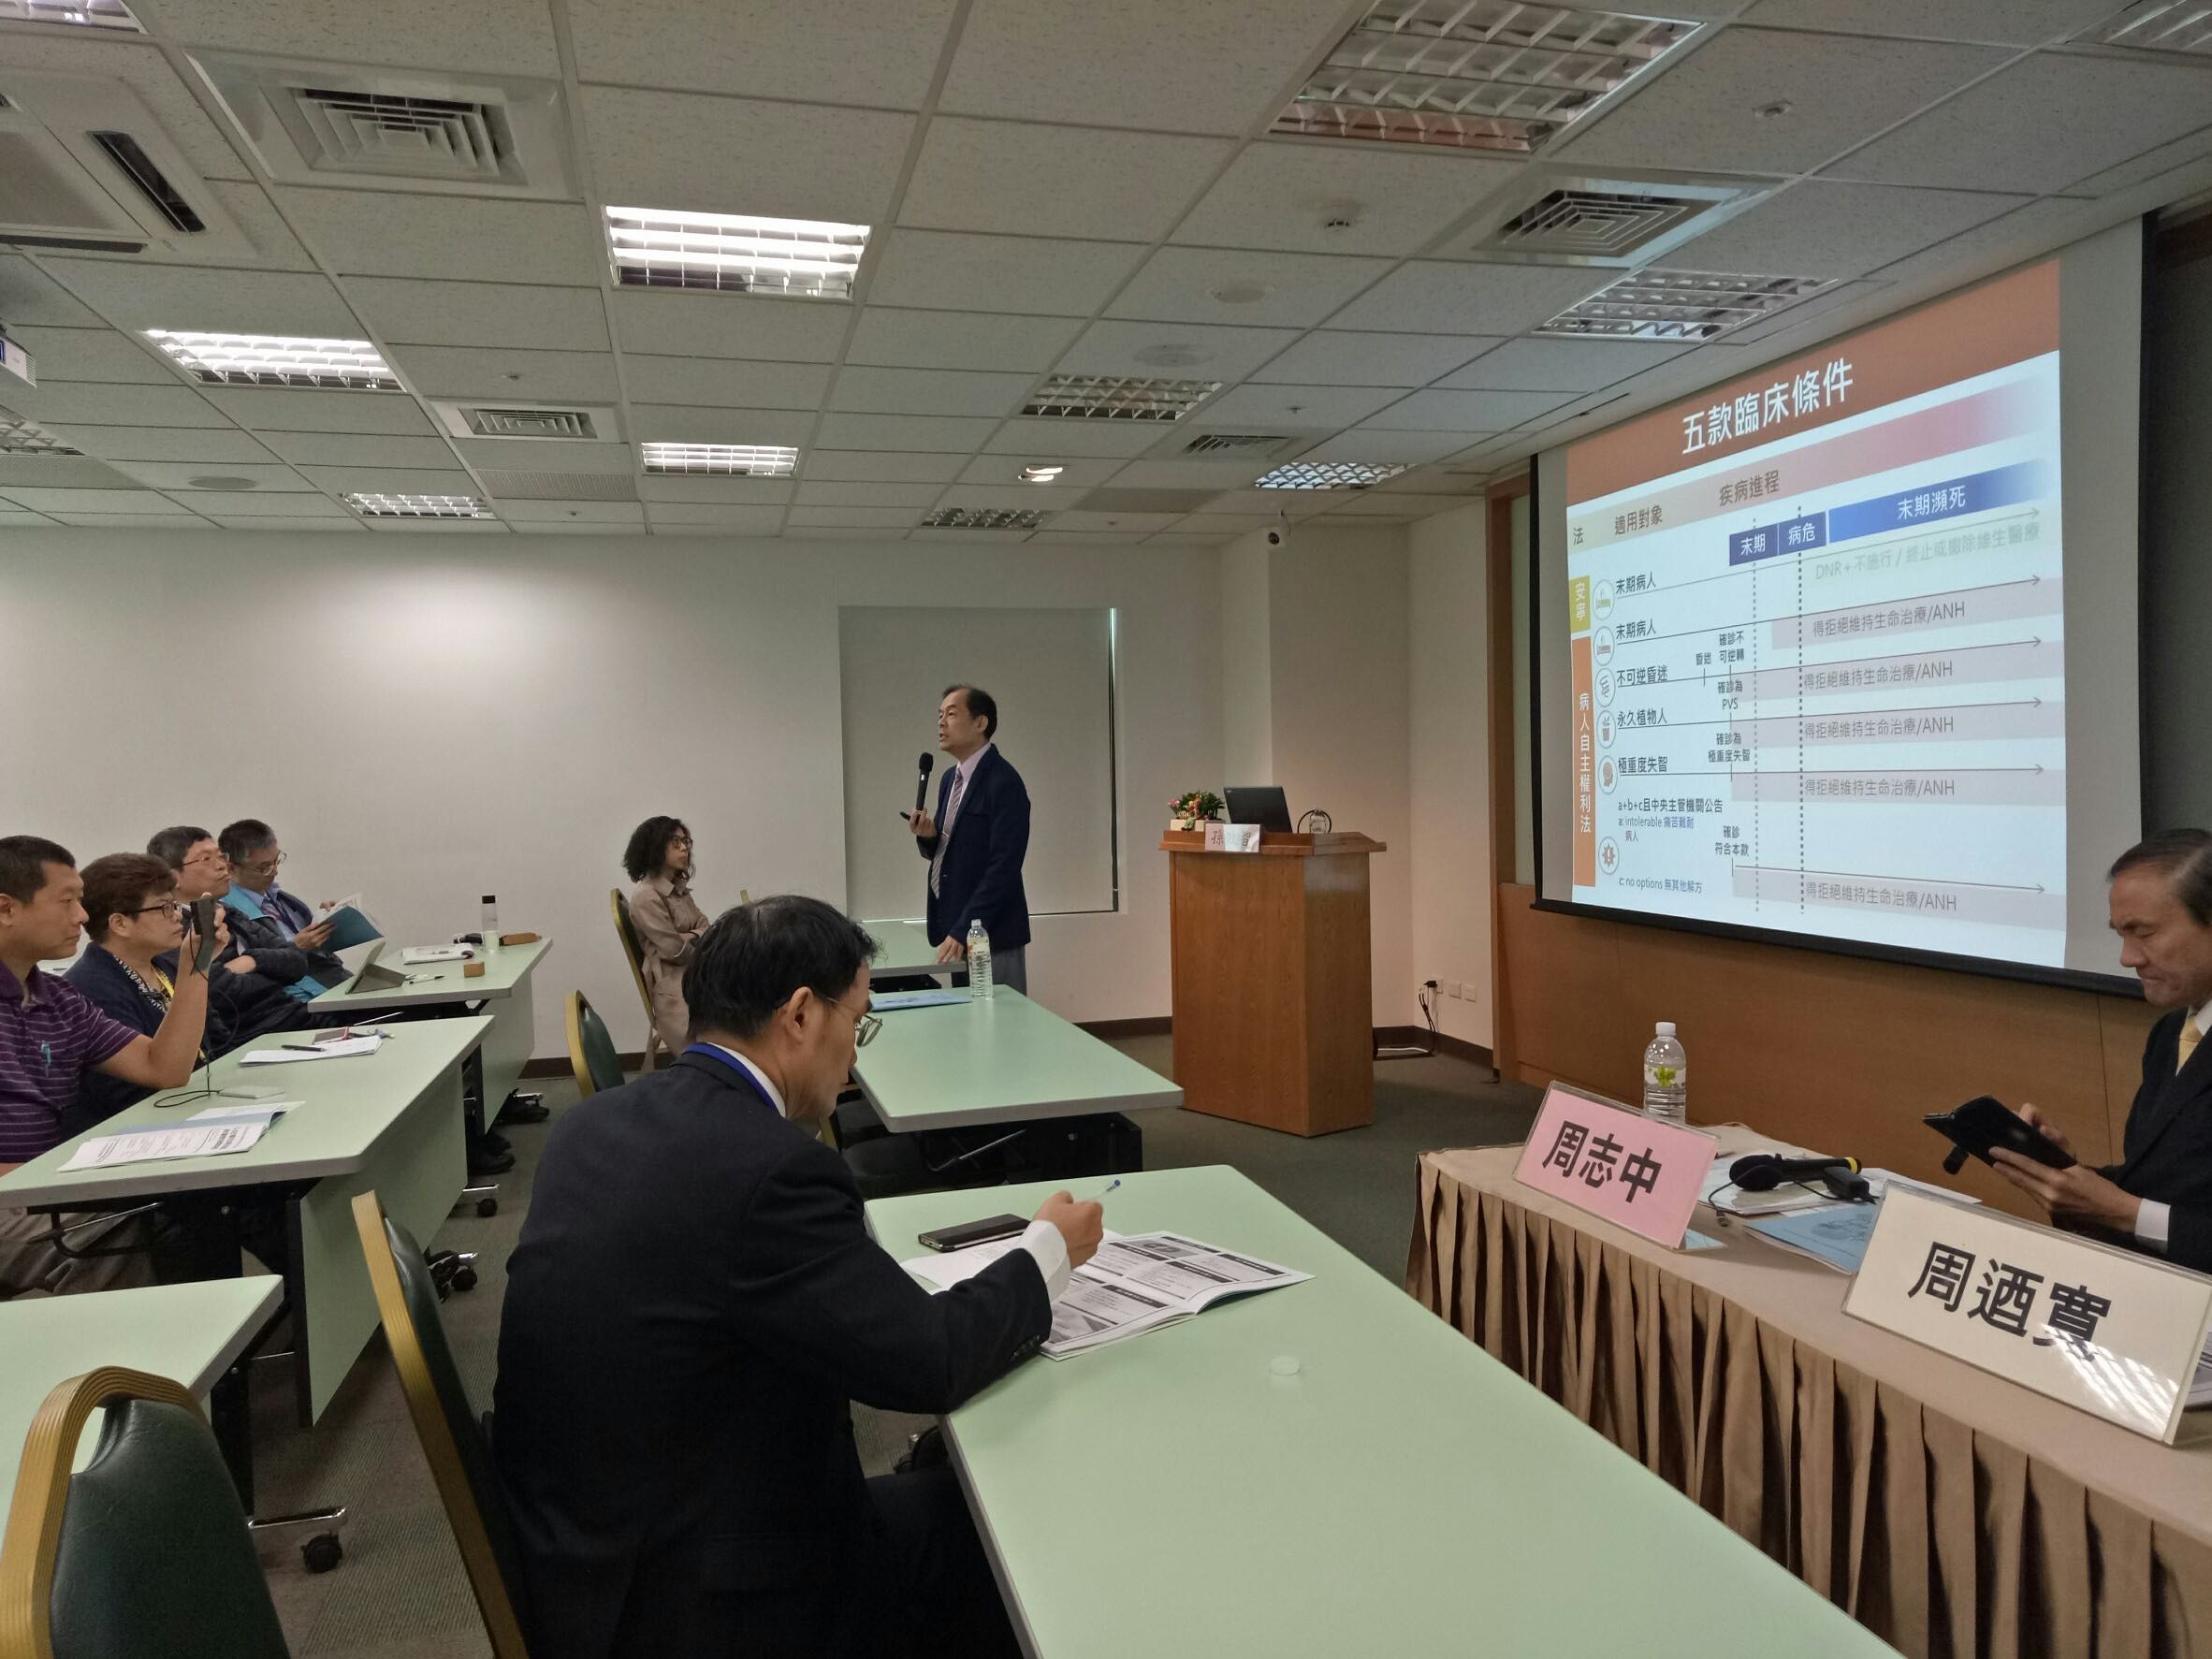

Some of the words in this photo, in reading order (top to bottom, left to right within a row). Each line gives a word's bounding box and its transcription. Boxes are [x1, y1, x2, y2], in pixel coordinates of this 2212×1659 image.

[1682, 357, 1854, 454] 五款臨床條件
[1719, 470, 1780, 506] 疾病進程
[1898, 485, 1966, 520] 末期瀕死
[1614, 505, 1663, 536] 適用對象
[1573, 527, 1585, 546] 法
[1740, 533, 1766, 556] 末期
[1788, 522, 1815, 546] 病危
[1815, 561, 1841, 579] DNR
[1616, 572, 1656, 594] 末期病人
[1576, 582, 1586, 621] 安寧
[1616, 618, 1656, 640] 末期病人
[1812, 602, 1966, 638] 得拒絕維持生命治療/ANH
[1617, 665, 1667, 686] 不可逆昏迷
[1804, 661, 1953, 690] 得拒絕維持生命治療/ANH
[1722, 698, 1739, 710] PVS
[1617, 707, 1667, 726] 永久植物人
[1804, 717, 1954, 739] 得拒絕維持生命治療/ANH
[1579, 692, 1591, 833] 病人自主權利法
[1618, 756, 1667, 774] 極重度失智
[1804, 779, 1955, 797] 得拒絕維持生命治療/ANH
[1625, 816, 1663, 827] intolerable
[1636, 879, 1663, 890] options
[1542, 1120, 1662, 1203] 周志中
